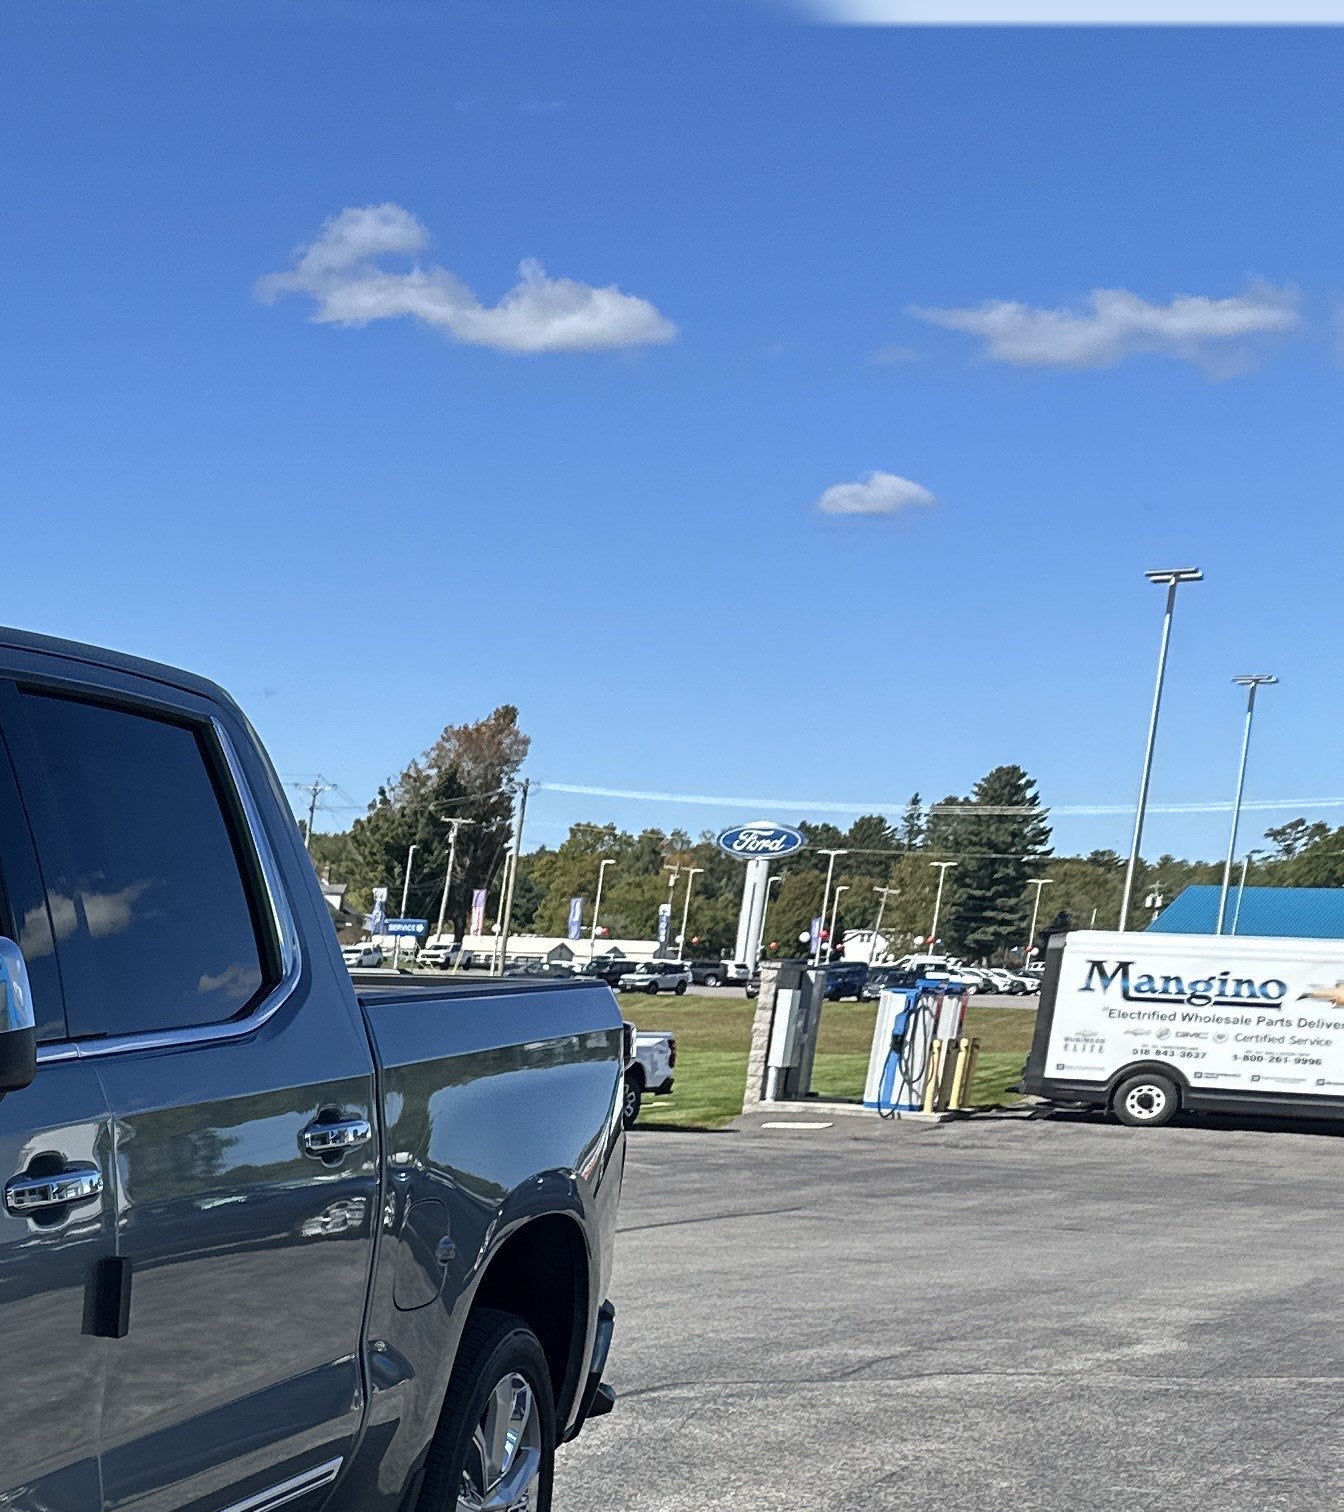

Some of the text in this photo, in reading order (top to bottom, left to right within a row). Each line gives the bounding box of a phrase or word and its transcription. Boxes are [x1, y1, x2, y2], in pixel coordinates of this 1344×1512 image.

[733, 829, 788, 851] Ford
[1077, 959, 1288, 1008] Mangino
[1181, 1011, 1253, 1026] Wholesale
[1256, 1015, 1293, 1028] Parts
[1234, 1033, 1333, 1048] Certified Service
